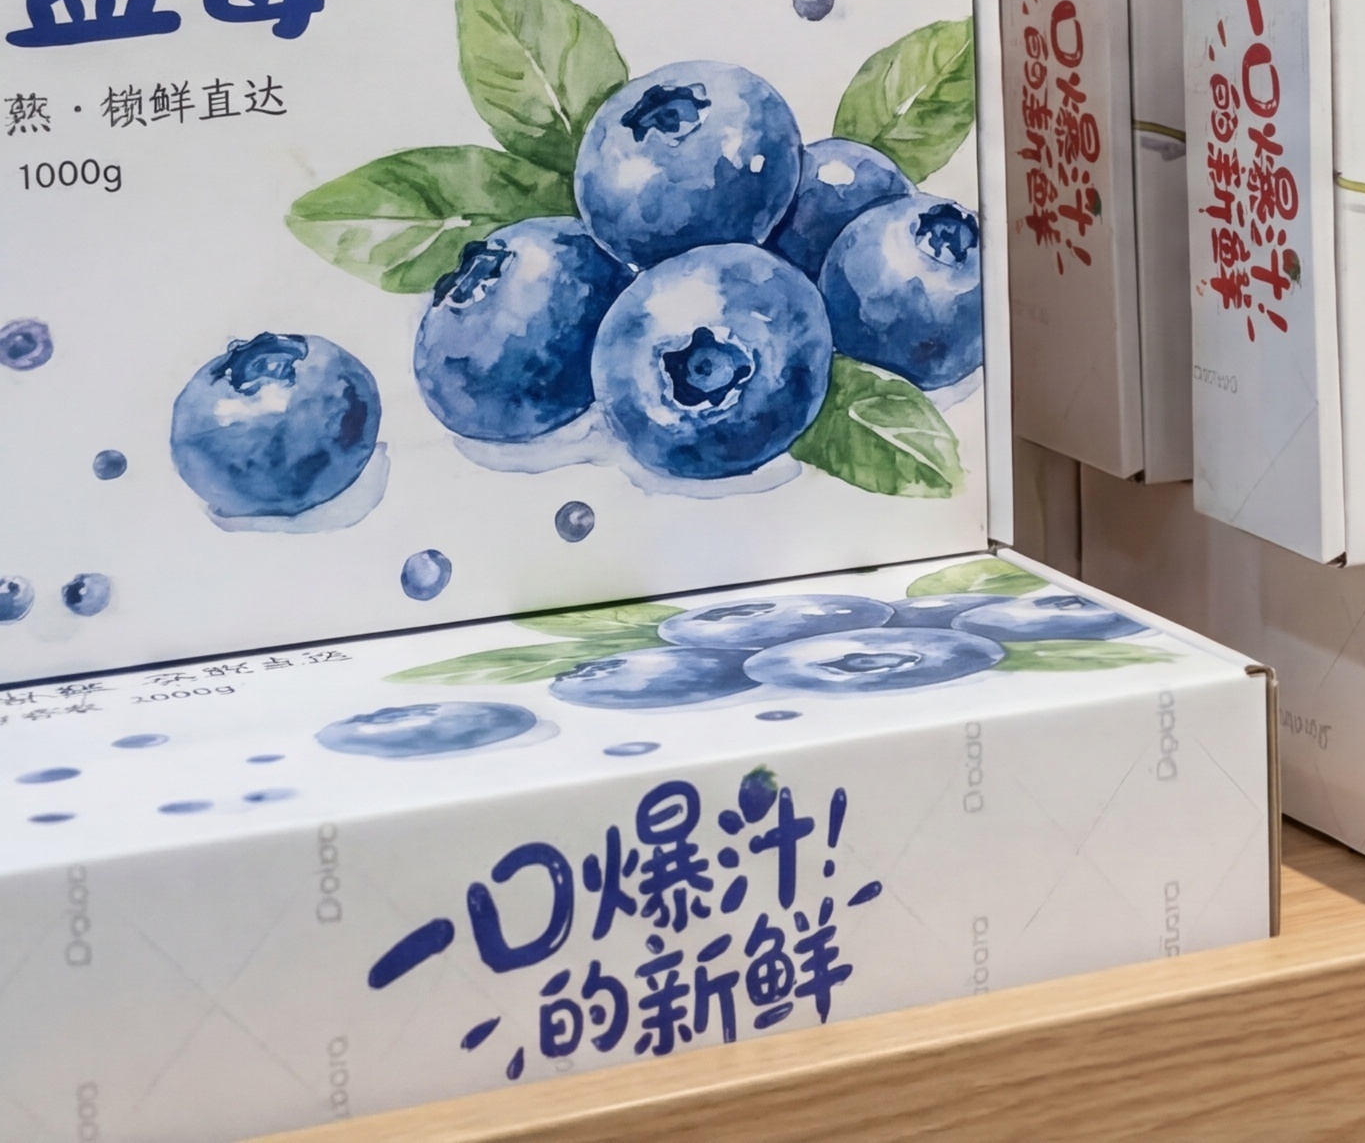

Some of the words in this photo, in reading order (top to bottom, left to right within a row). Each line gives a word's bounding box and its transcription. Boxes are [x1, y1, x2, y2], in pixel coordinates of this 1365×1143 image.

[19, 158, 122, 193] 1000g
[540, 901, 853, 1057] 的新鲜
